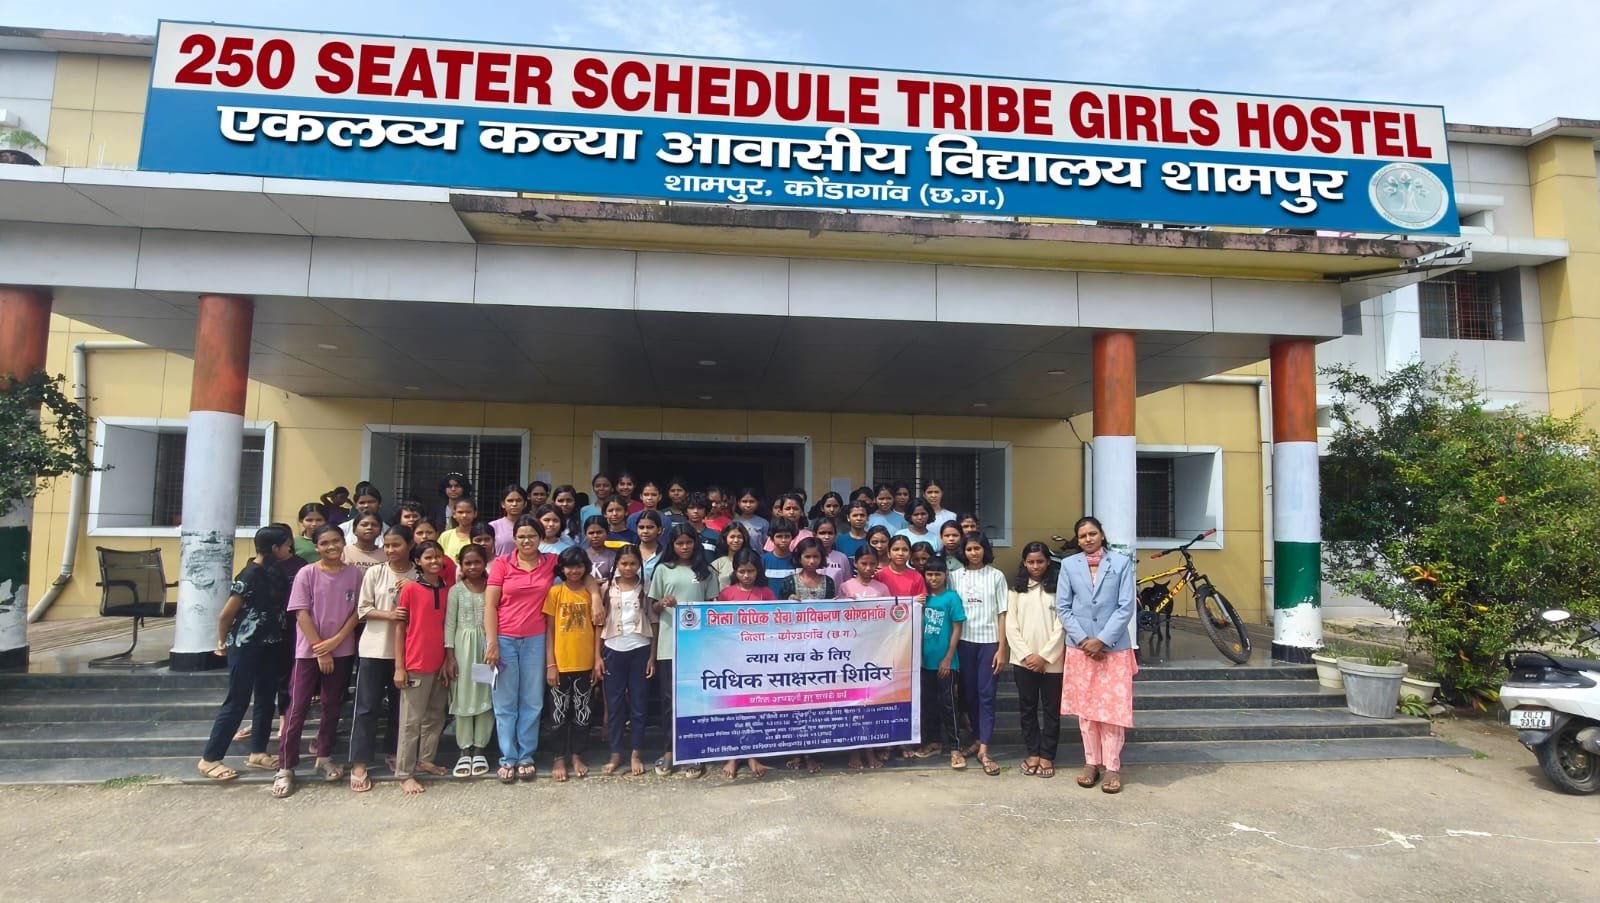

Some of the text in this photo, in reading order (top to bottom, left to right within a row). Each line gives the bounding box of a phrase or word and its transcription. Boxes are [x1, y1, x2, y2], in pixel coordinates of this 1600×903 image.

[175, 34, 1433, 159] 250 SEATER SCHEDULE TRIBE GIRLS HOSTEL
[217, 106, 464, 151] एकलव्य
[479, 121, 642, 161] कन्या
[656, 127, 911, 175] आवासीय
[926, 133, 1146, 190] विद्यालय
[1162, 162, 1349, 214] शामपुर
[665, 175, 1005, 209] शामपुर, कोंडागांव (छ.ग.)
[746, 653, 779, 664] न्याय
[810, 648, 823, 661] के
[701, 661, 893, 690] विधिक साक्षरता शिविर
